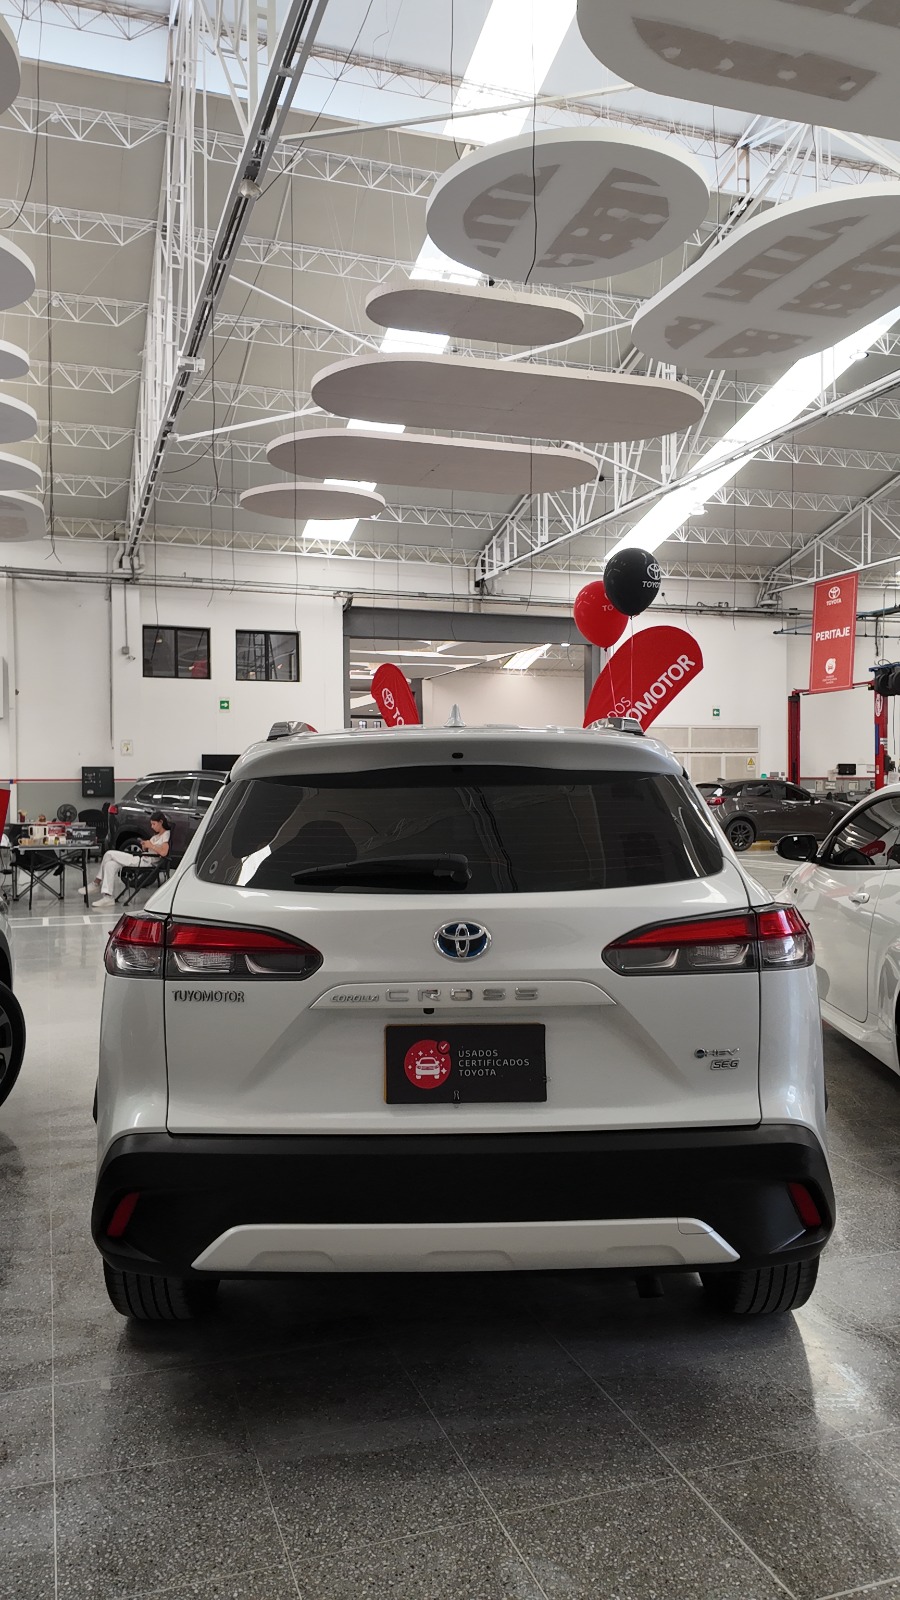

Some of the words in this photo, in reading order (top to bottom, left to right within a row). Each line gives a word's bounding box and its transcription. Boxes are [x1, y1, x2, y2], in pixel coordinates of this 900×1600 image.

[826, 598, 842, 606] TOYOTA
[815, 626, 851, 641] PERITAJE
[625, 654, 695, 722] OMOTOR
[172, 990, 245, 1003] TUYOMOTOR
[331, 994, 380, 1003] COROLLA
[385, 988, 539, 1002] CROSS
[458, 1049, 499, 1058] USADOS
[458, 1058, 530, 1068] CERTIFICADOS
[712, 1060, 740, 1070] SEG
[458, 1068, 497, 1077] TOYOTA
